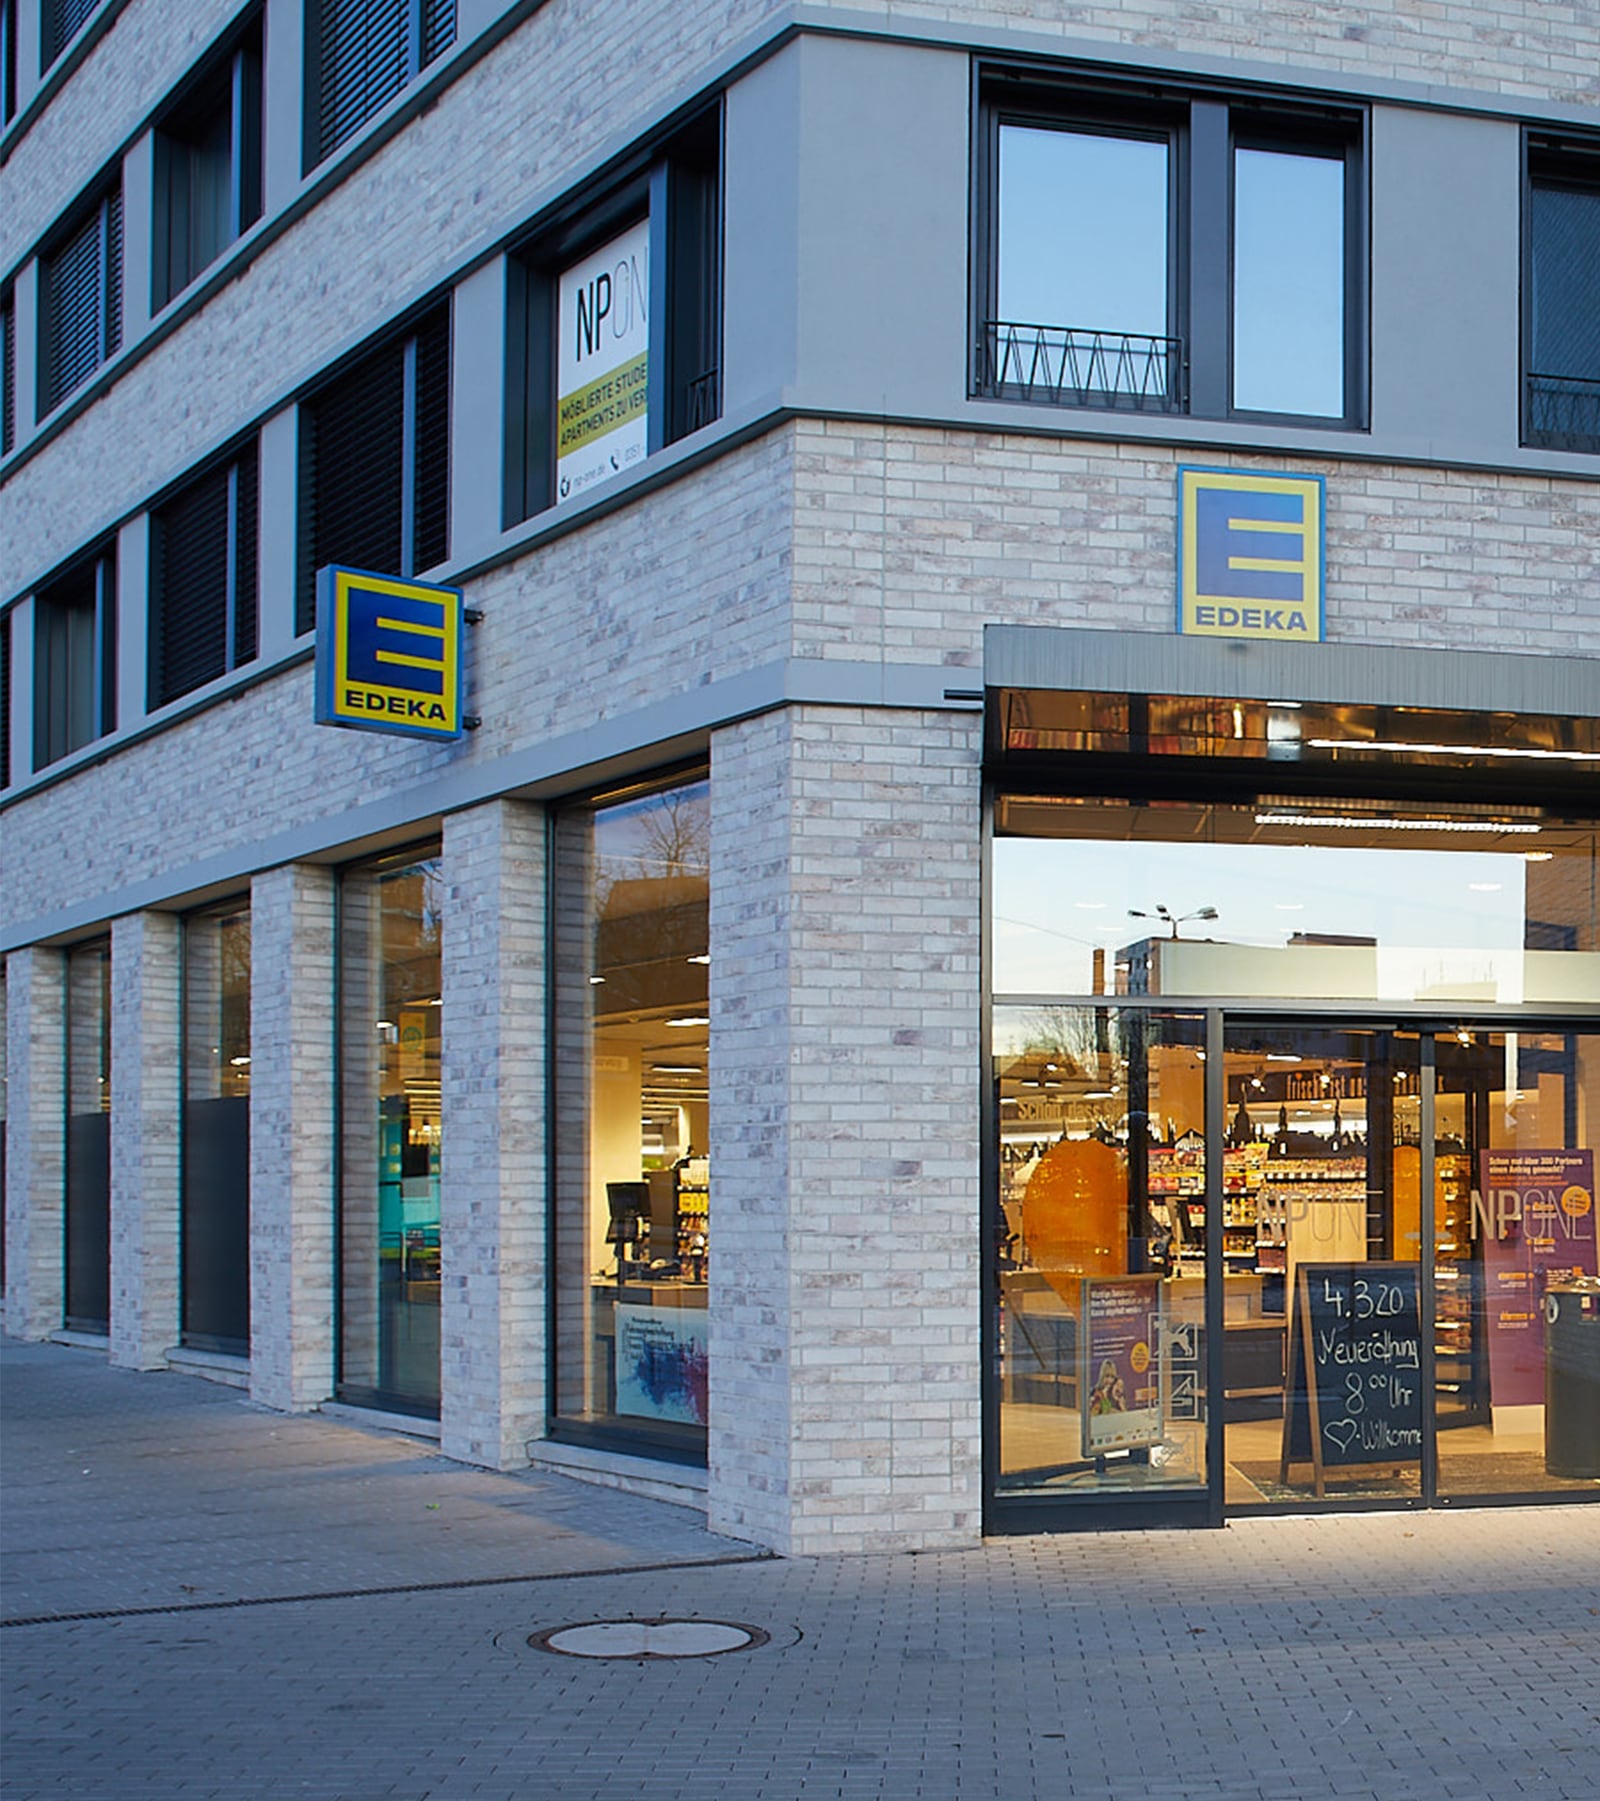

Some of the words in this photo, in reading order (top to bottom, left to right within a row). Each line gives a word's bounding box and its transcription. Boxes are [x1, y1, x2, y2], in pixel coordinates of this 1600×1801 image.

[561, 381, 613, 425] MÖBLIERTE
[561, 406, 614, 448] APARTMENTS
[615, 398, 628, 418] ZU
[1196, 487, 1303, 601] E
[347, 587, 444, 695] E
[1196, 606, 1307, 631] EDEKA
[345, 689, 447, 721] EDEKA
[1470, 1189, 1592, 1240] NPONE
[1389, 1373, 1413, 1409] Uhr
